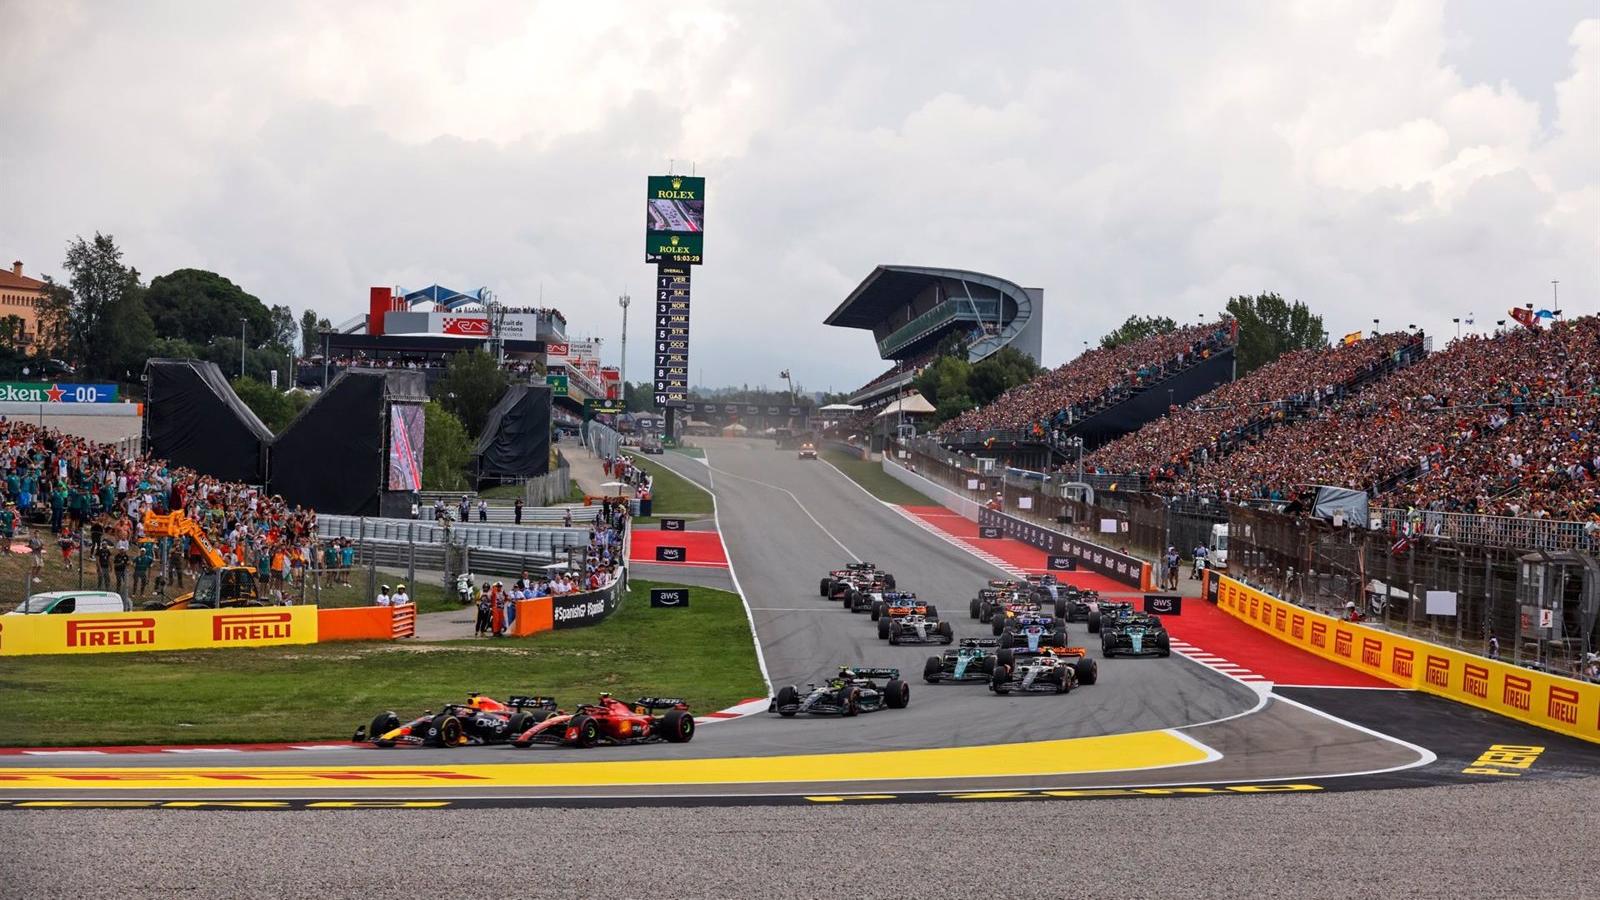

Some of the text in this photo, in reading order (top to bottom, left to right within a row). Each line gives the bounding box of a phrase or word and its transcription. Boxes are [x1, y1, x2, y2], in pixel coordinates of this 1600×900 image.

[658, 190, 694, 199] ROLEX
[660, 246, 690, 254] ROLEX
[76, 387, 96, 402] 0.0
[660, 592, 679, 600] aws
[1154, 599, 1172, 607] aws
[66, 618, 156, 647] PIRELLI
[212, 612, 291, 641] PIRELLI
[1335, 629, 1352, 658] PIRELLI
[1362, 637, 1382, 668] PIRELLI
[1392, 647, 1414, 678] PIRELLI
[1426, 654, 1450, 688] PIRELLI
[1463, 663, 1488, 699] PIRELLI
[1503, 674, 1531, 711] PIRELLI
[1548, 685, 1578, 724] PIRELLI
